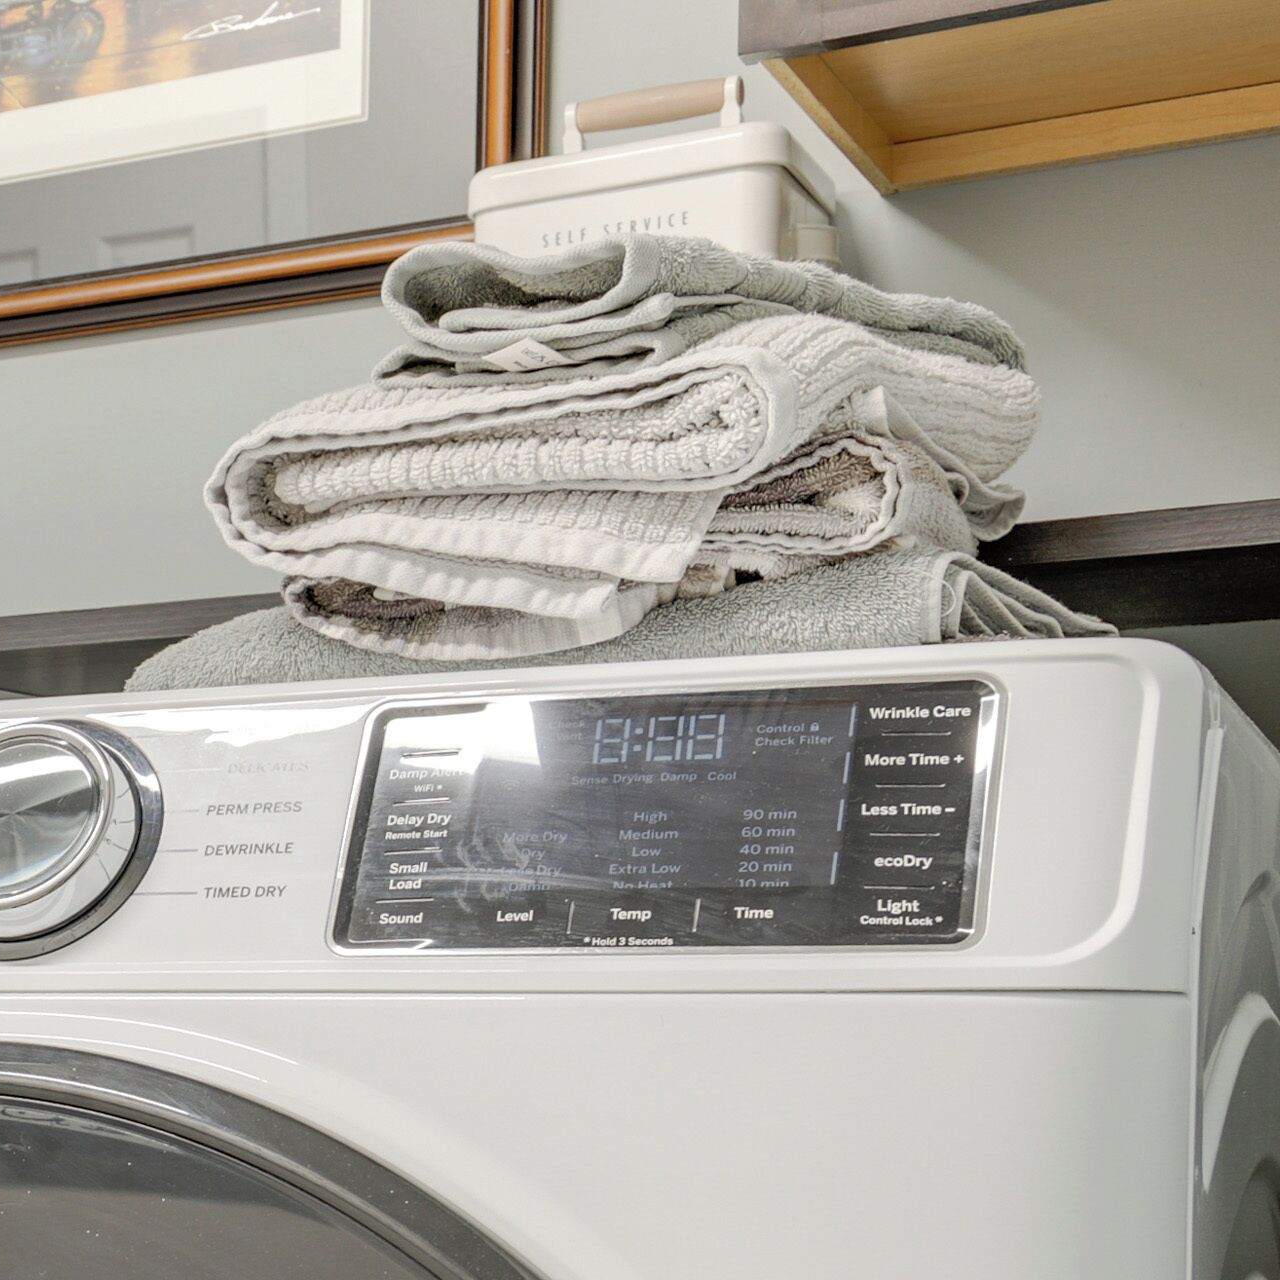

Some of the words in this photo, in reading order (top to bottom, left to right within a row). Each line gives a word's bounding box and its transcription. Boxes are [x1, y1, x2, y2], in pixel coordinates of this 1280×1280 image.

[542, 228, 587, 248] SELF
[603, 211, 689, 235] SERVICE
[869, 707, 930, 719] Wrinkle
[933, 705, 972, 717] Care
[756, 723, 805, 734] Control
[755, 735, 795, 747] Check
[799, 735, 833, 745] Filter
[865, 754, 905, 766] More
[909, 753, 949, 765] Time
[390, 769, 428, 781] Damp
[572, 776, 608, 785] Sense
[613, 773, 654, 784] Drying
[660, 772, 697, 783] Damp
[708, 771, 737, 781] Cool
[414, 784, 434, 793] WiFi
[207, 804, 249, 816] PERM
[253, 801, 303, 814] PRESS
[743, 809, 764, 820] 90
[768, 809, 797, 819] min
[861, 804, 898, 816] Less
[900, 803, 942, 815] Time
[387, 814, 424, 827] Delay
[427, 813, 451, 825] Dry
[634, 811, 668, 823] High
[385, 831, 421, 840] Remote
[423, 829, 448, 838] Start
[502, 832, 539, 843] More
[543, 831, 568, 843] Dry
[619, 828, 679, 840] Medium
[741, 827, 762, 838] 60
[767, 827, 796, 837] min
[204, 842, 294, 857] DEWRINKLE
[631, 847, 661, 857] Low
[740, 845, 761, 855] 40
[765, 844, 794, 854] min
[739, 862, 759, 872] 20
[763, 861, 792, 872] min
[874, 854, 933, 869] ecoDry
[389, 862, 428, 874] Small
[609, 864, 647, 875] Extra
[651, 863, 681, 874] Low
[389, 879, 422, 890] Load
[204, 887, 251, 898] TIMED
[255, 886, 287, 897] DRY
[877, 899, 920, 914] Light
[379, 913, 423, 924] Sound
[496, 910, 533, 922] Level
[610, 908, 652, 921] Temp
[734, 907, 774, 919] Time
[860, 915, 903, 926] Control
[905, 916, 933, 926] Lock
[591, 936, 617, 946] Hold
[618, 936, 626, 945] 3
[628, 936, 673, 946] Seconds
